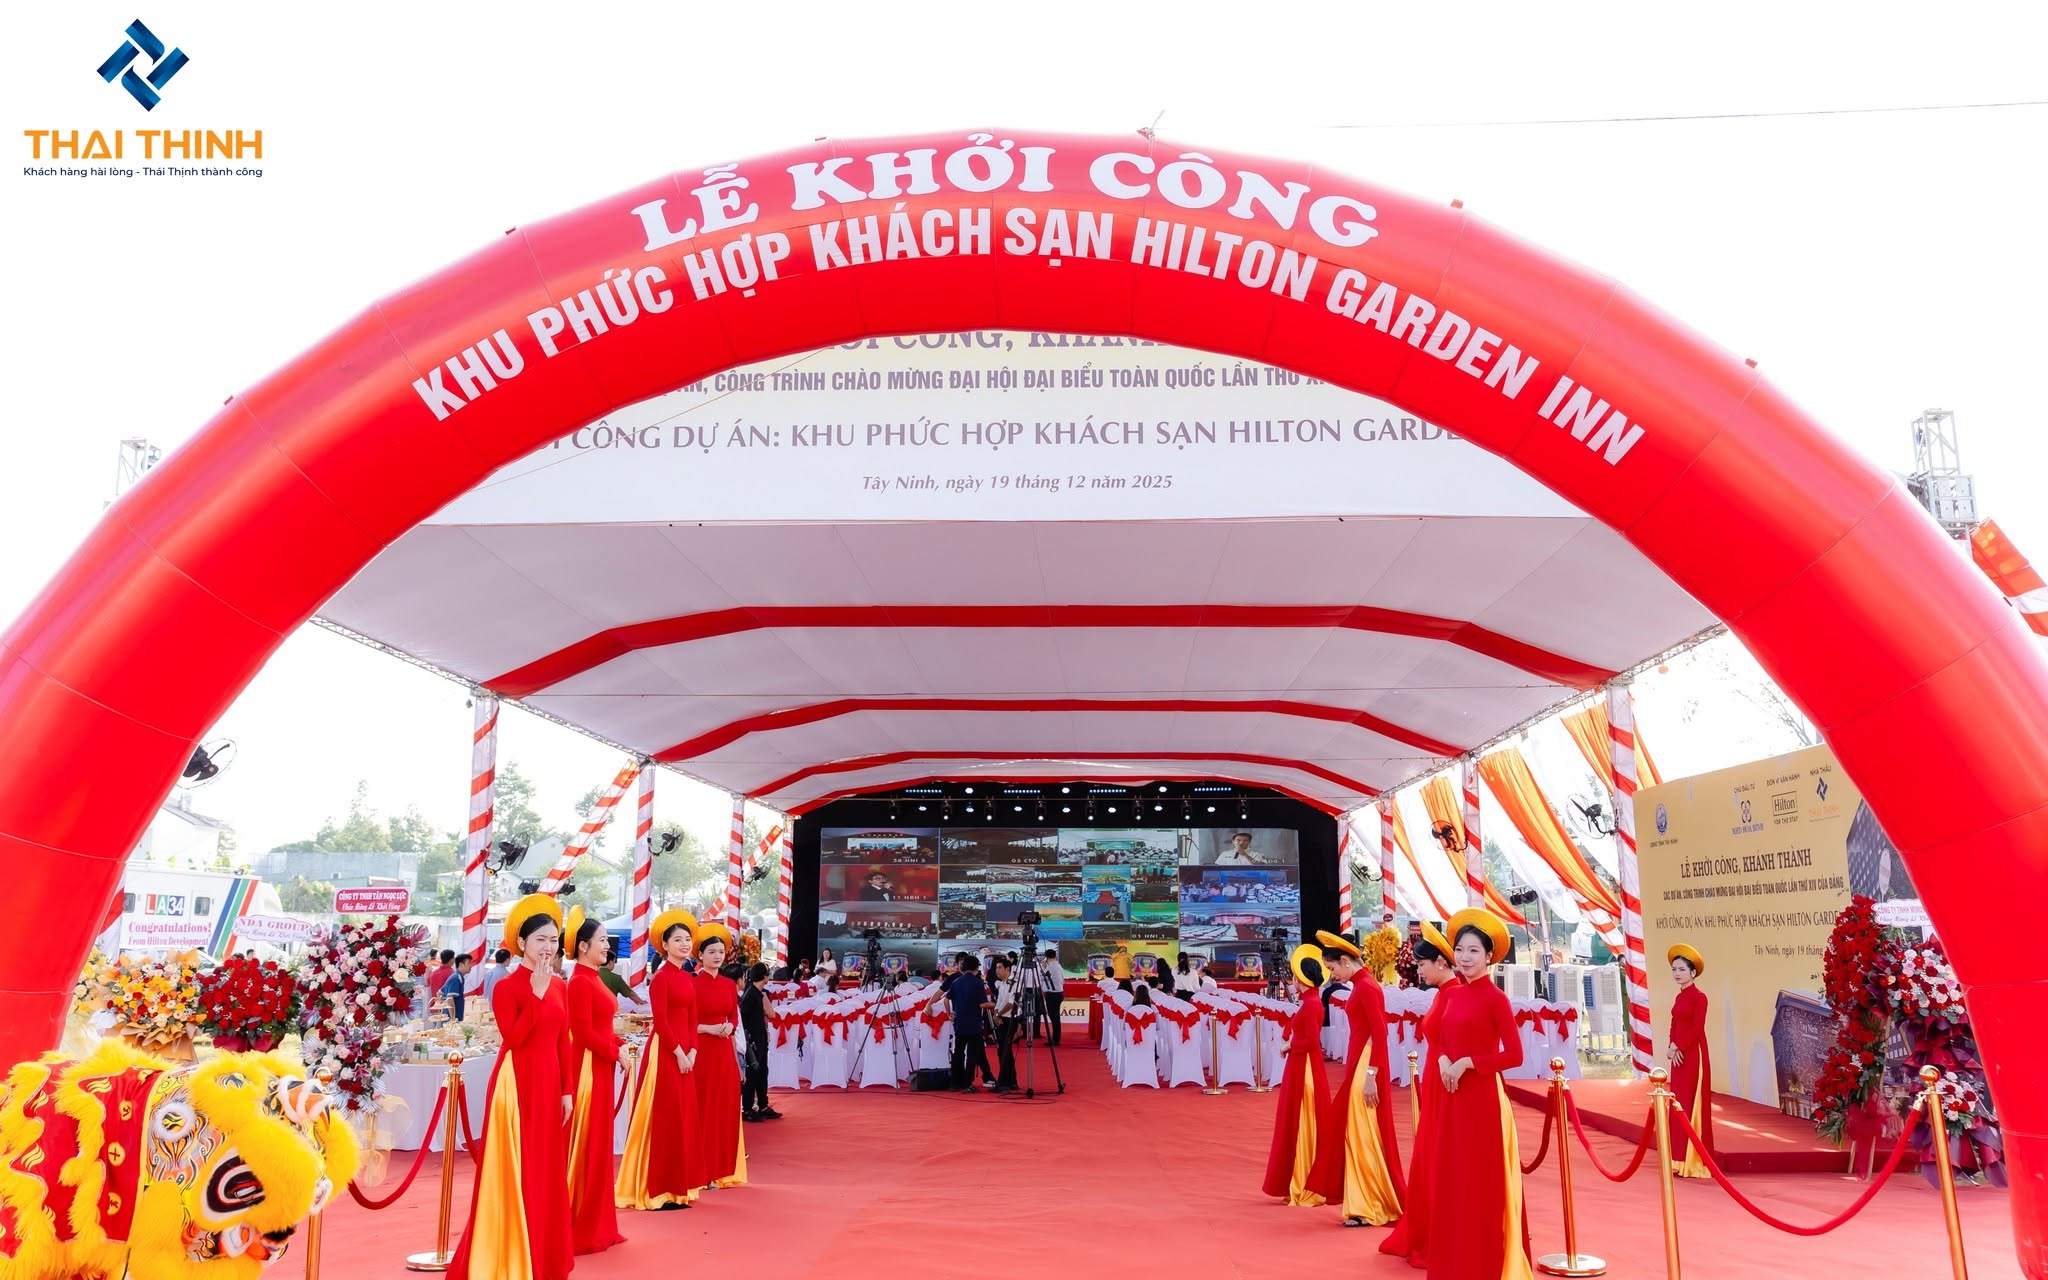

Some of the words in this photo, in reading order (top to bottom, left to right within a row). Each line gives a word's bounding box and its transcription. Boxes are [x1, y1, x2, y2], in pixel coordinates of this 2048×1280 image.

[631, 163, 759, 252] LỄ
[786, 133, 1056, 210] KHỞI
[1089, 152, 1379, 247] CÔNG
[412, 329, 525, 421] KHU
[527, 268, 674, 358] PHỨC
[682, 233, 791, 300] HỢP
[809, 203, 991, 271] KHÁCH
[1004, 207, 1113, 267] SẠN
[1131, 217, 1319, 303] HILTON
[1325, 268, 1540, 400] GARDEN
[1537, 374, 1646, 466] INN
[714, 370, 765, 392] CÔNG
[771, 369, 826, 391] TRÌNH
[832, 368, 881, 390] CHÀO
[888, 367, 943, 390] MỪNG
[949, 370, 980, 393] ĐẠI
[986, 366, 1018, 392] HỘI
[1024, 369, 1055, 392] ĐẠI
[1061, 361, 1103, 388] BIỂU
[1110, 365, 1159, 388] TOÀN
[1165, 361, 1215, 389] QUỐC
[1222, 361, 1258, 387] LẦN
[572, 420, 661, 449] CÔNG
[673, 422, 719, 454] DỰ
[727, 418, 780, 448] ÁN:
[792, 424, 855, 447] KHU
[867, 416, 950, 446] PHỨC
[961, 419, 1024, 451] HỢP
[1035, 414, 1144, 445] KHÁCH
[1156, 421, 1216, 450] SẠN
[1229, 419, 1341, 443] HILTON
[1353, 418, 1463, 441] GARD
[862, 476, 890, 493] Tây
[895, 475, 940, 491] Ninh,
[946, 475, 984, 493] ngày
[991, 475, 1010, 489] 19
[1015, 474, 1060, 493] tháng
[1067, 475, 1086, 489] 12
[1091, 475, 1126, 489] năm
[1131, 475, 1173, 489] 2025
[1774, 797, 1796, 812] Hilton
[1714, 854, 1741, 876] CÔNG,
[1742, 849, 1775, 872] KHÁNH
[1777, 845, 1812, 869] THÀNH
[128, 921, 212, 934] Congratulations!
[1704, 915, 1716, 928] KHU
[1748, 910, 1770, 928] KHÁCH
[1772, 914, 1785, 930] SẠN
[1787, 912, 1811, 927] HILTON
[1813, 910, 1842, 926] GARDE
[1754, 945, 1764, 956] Tây
[1782, 945, 1795, 958] ngày
[1797, 946, 1805, 955] 19
[1060, 1006, 1086, 1017] ÁCH
